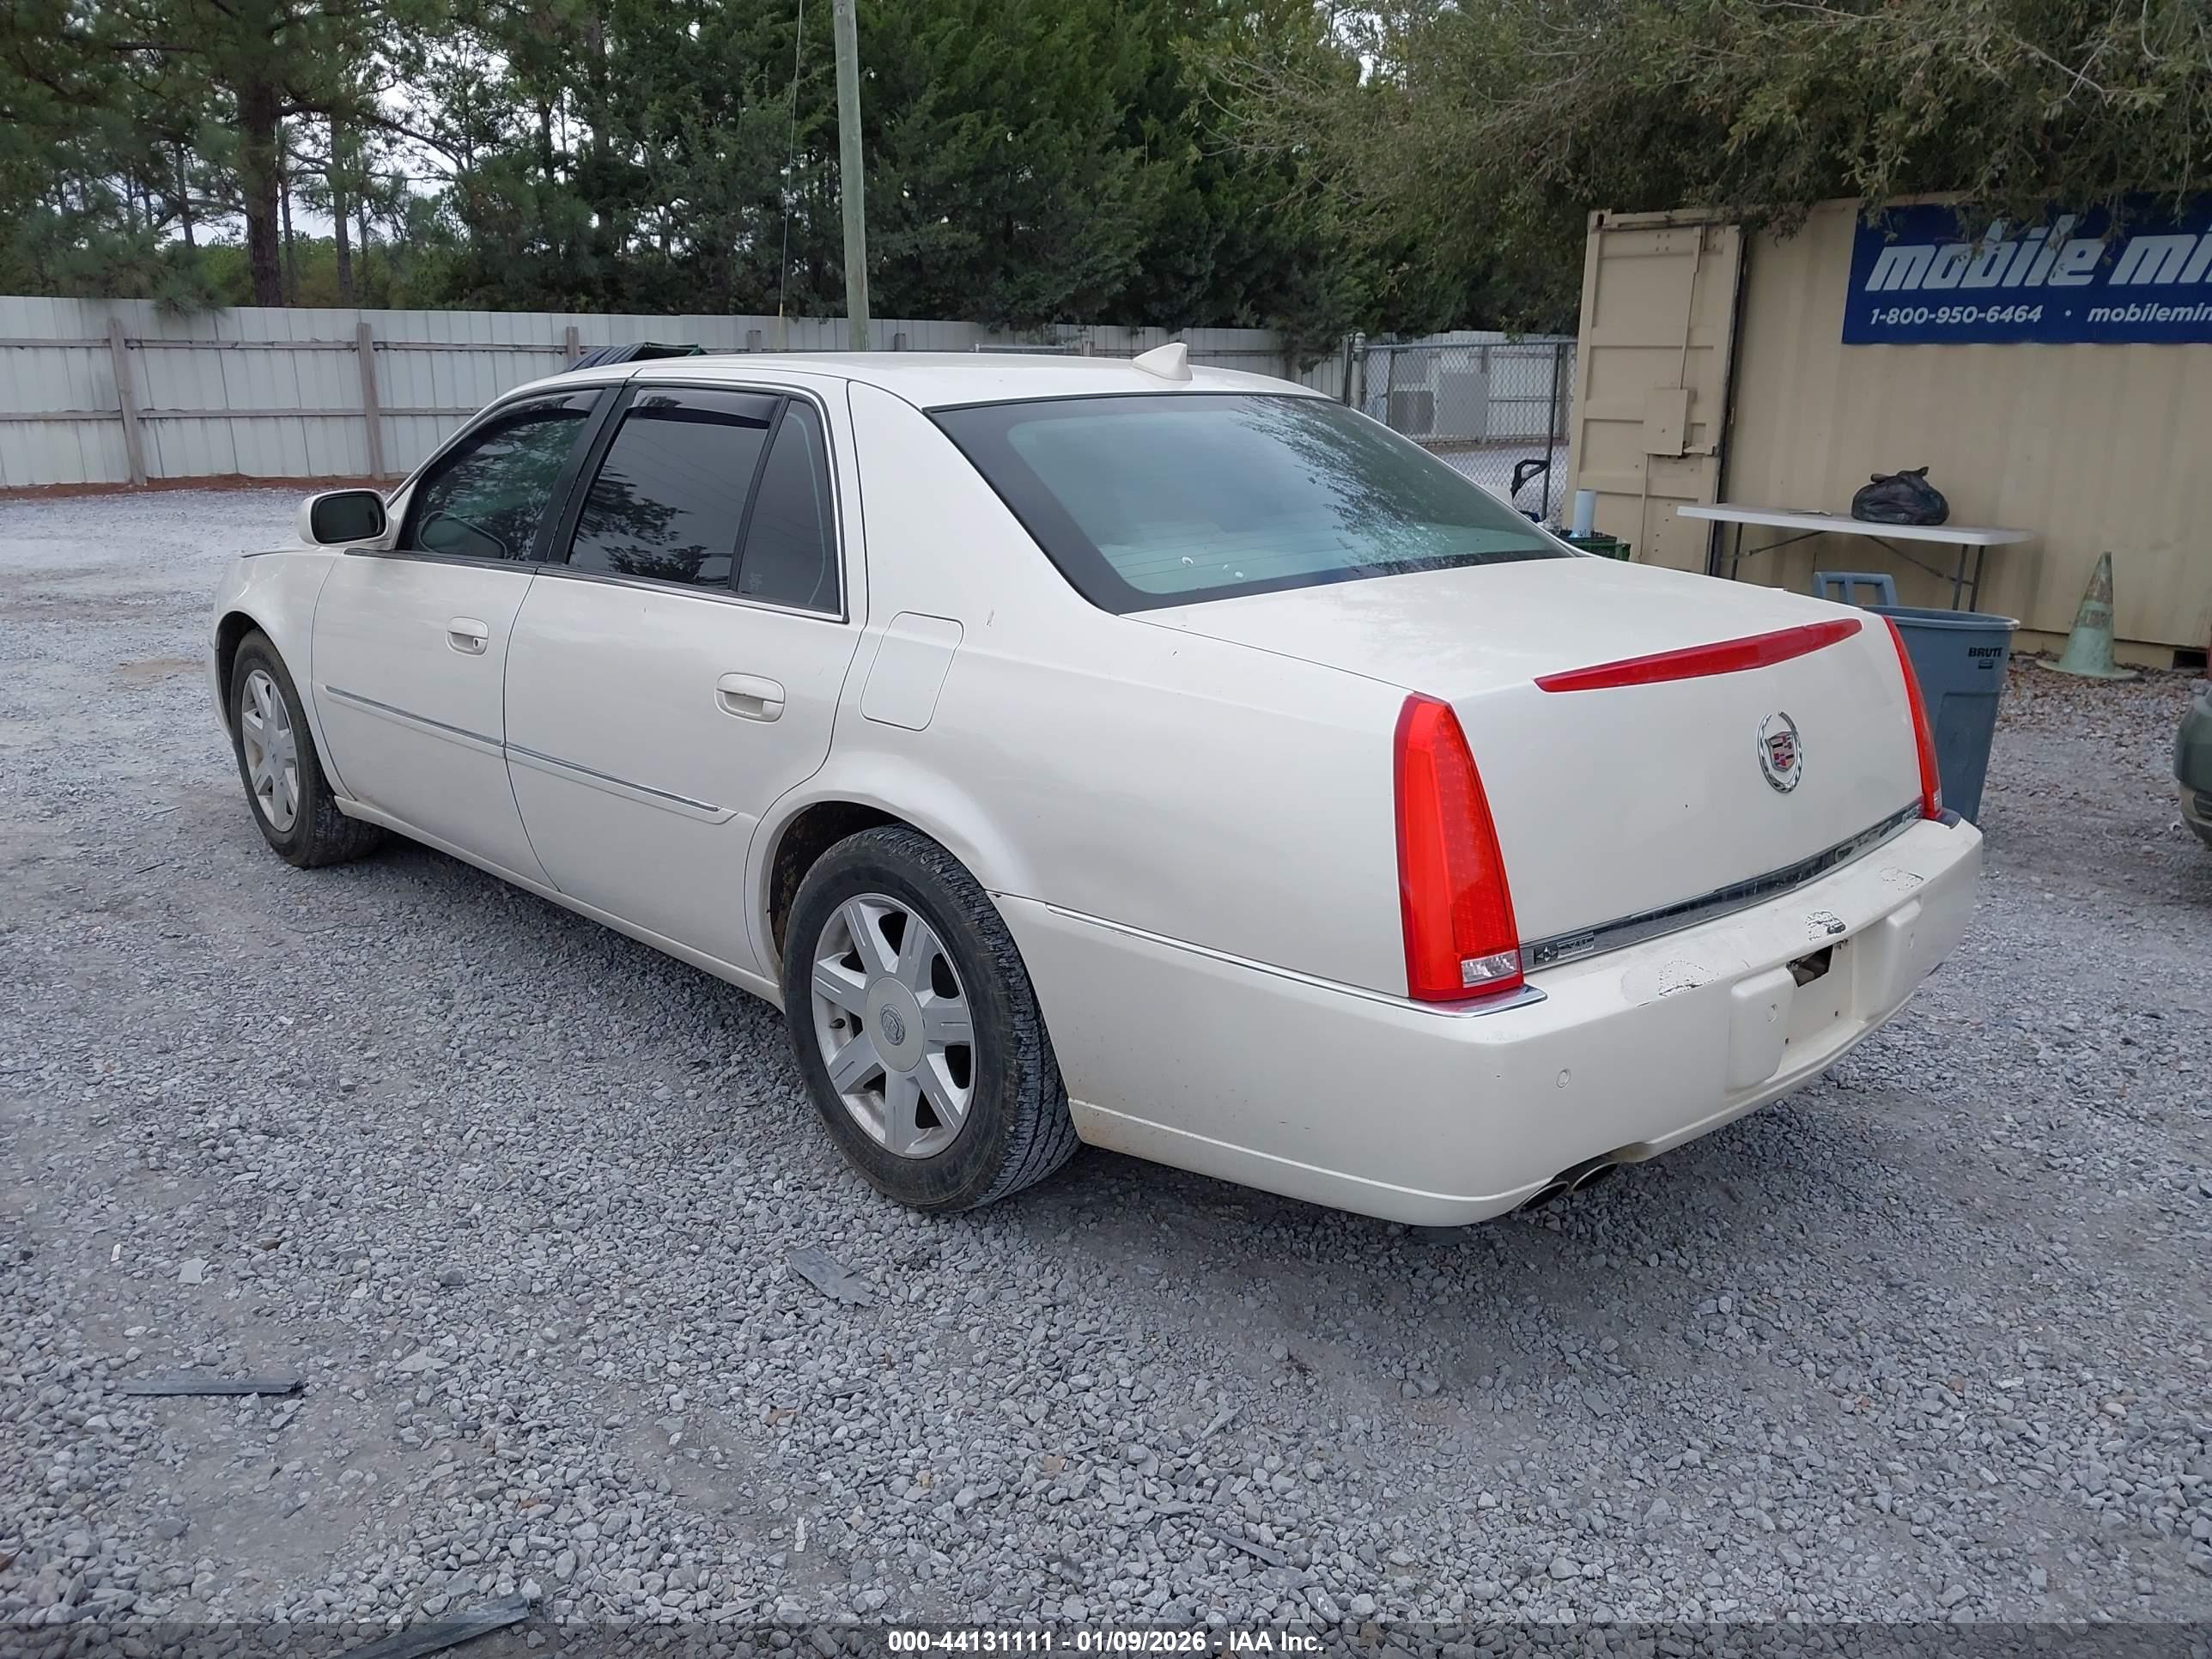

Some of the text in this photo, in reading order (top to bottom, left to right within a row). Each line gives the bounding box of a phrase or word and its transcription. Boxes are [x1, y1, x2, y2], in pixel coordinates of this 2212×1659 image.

[1865, 215, 2212, 291] mobile mi
[1870, 305, 2044, 325] 1-800-950-6464
